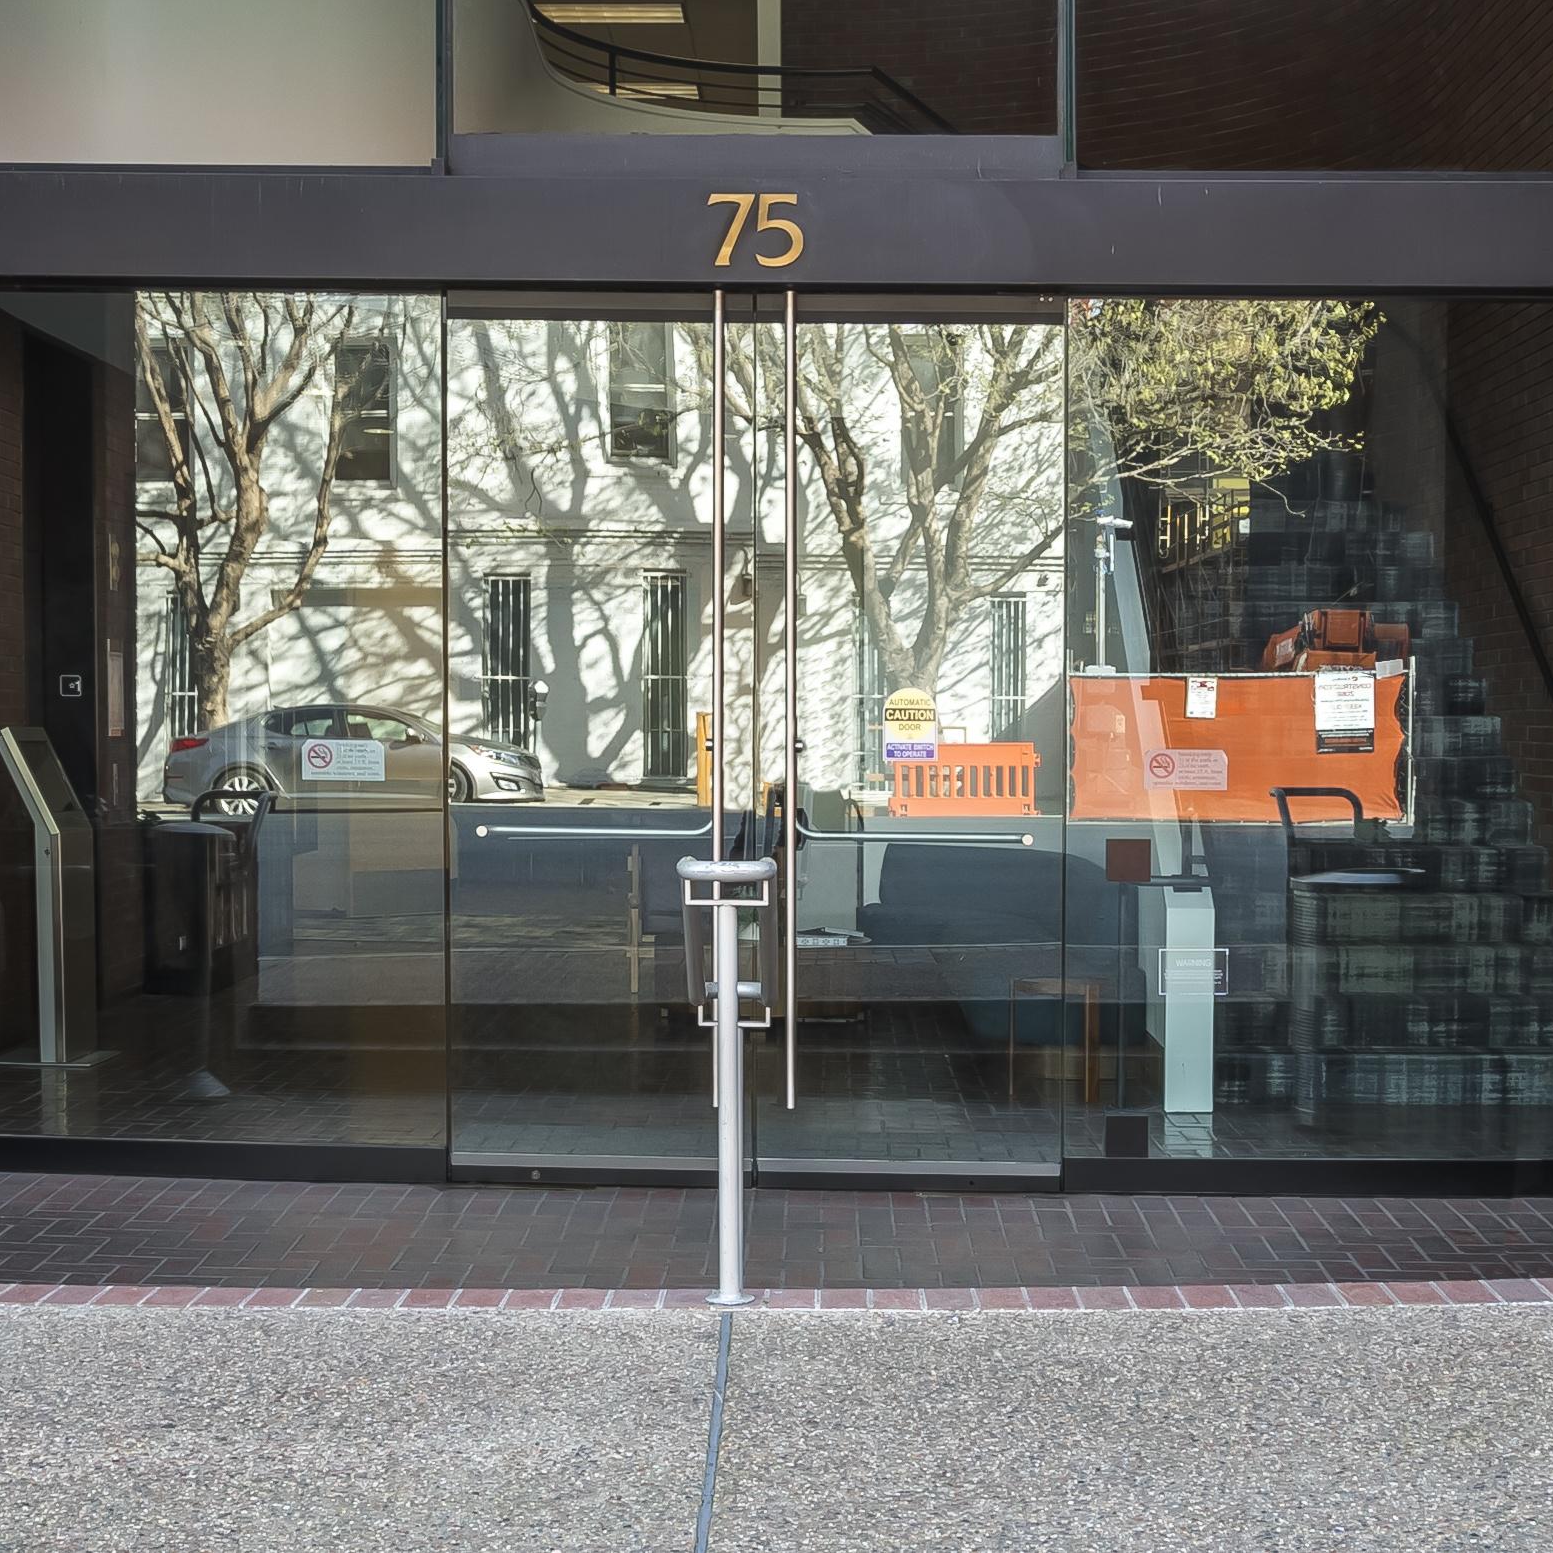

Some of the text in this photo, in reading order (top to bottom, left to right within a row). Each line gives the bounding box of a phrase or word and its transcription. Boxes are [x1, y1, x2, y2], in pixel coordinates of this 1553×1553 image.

[706, 192, 805, 268] 75
[889, 698, 932, 706] AUTOMATIC
[886, 709, 935, 721] CAUTION
[898, 723, 921, 731] DOOR
[1175, 957, 1213, 967] WARNING
